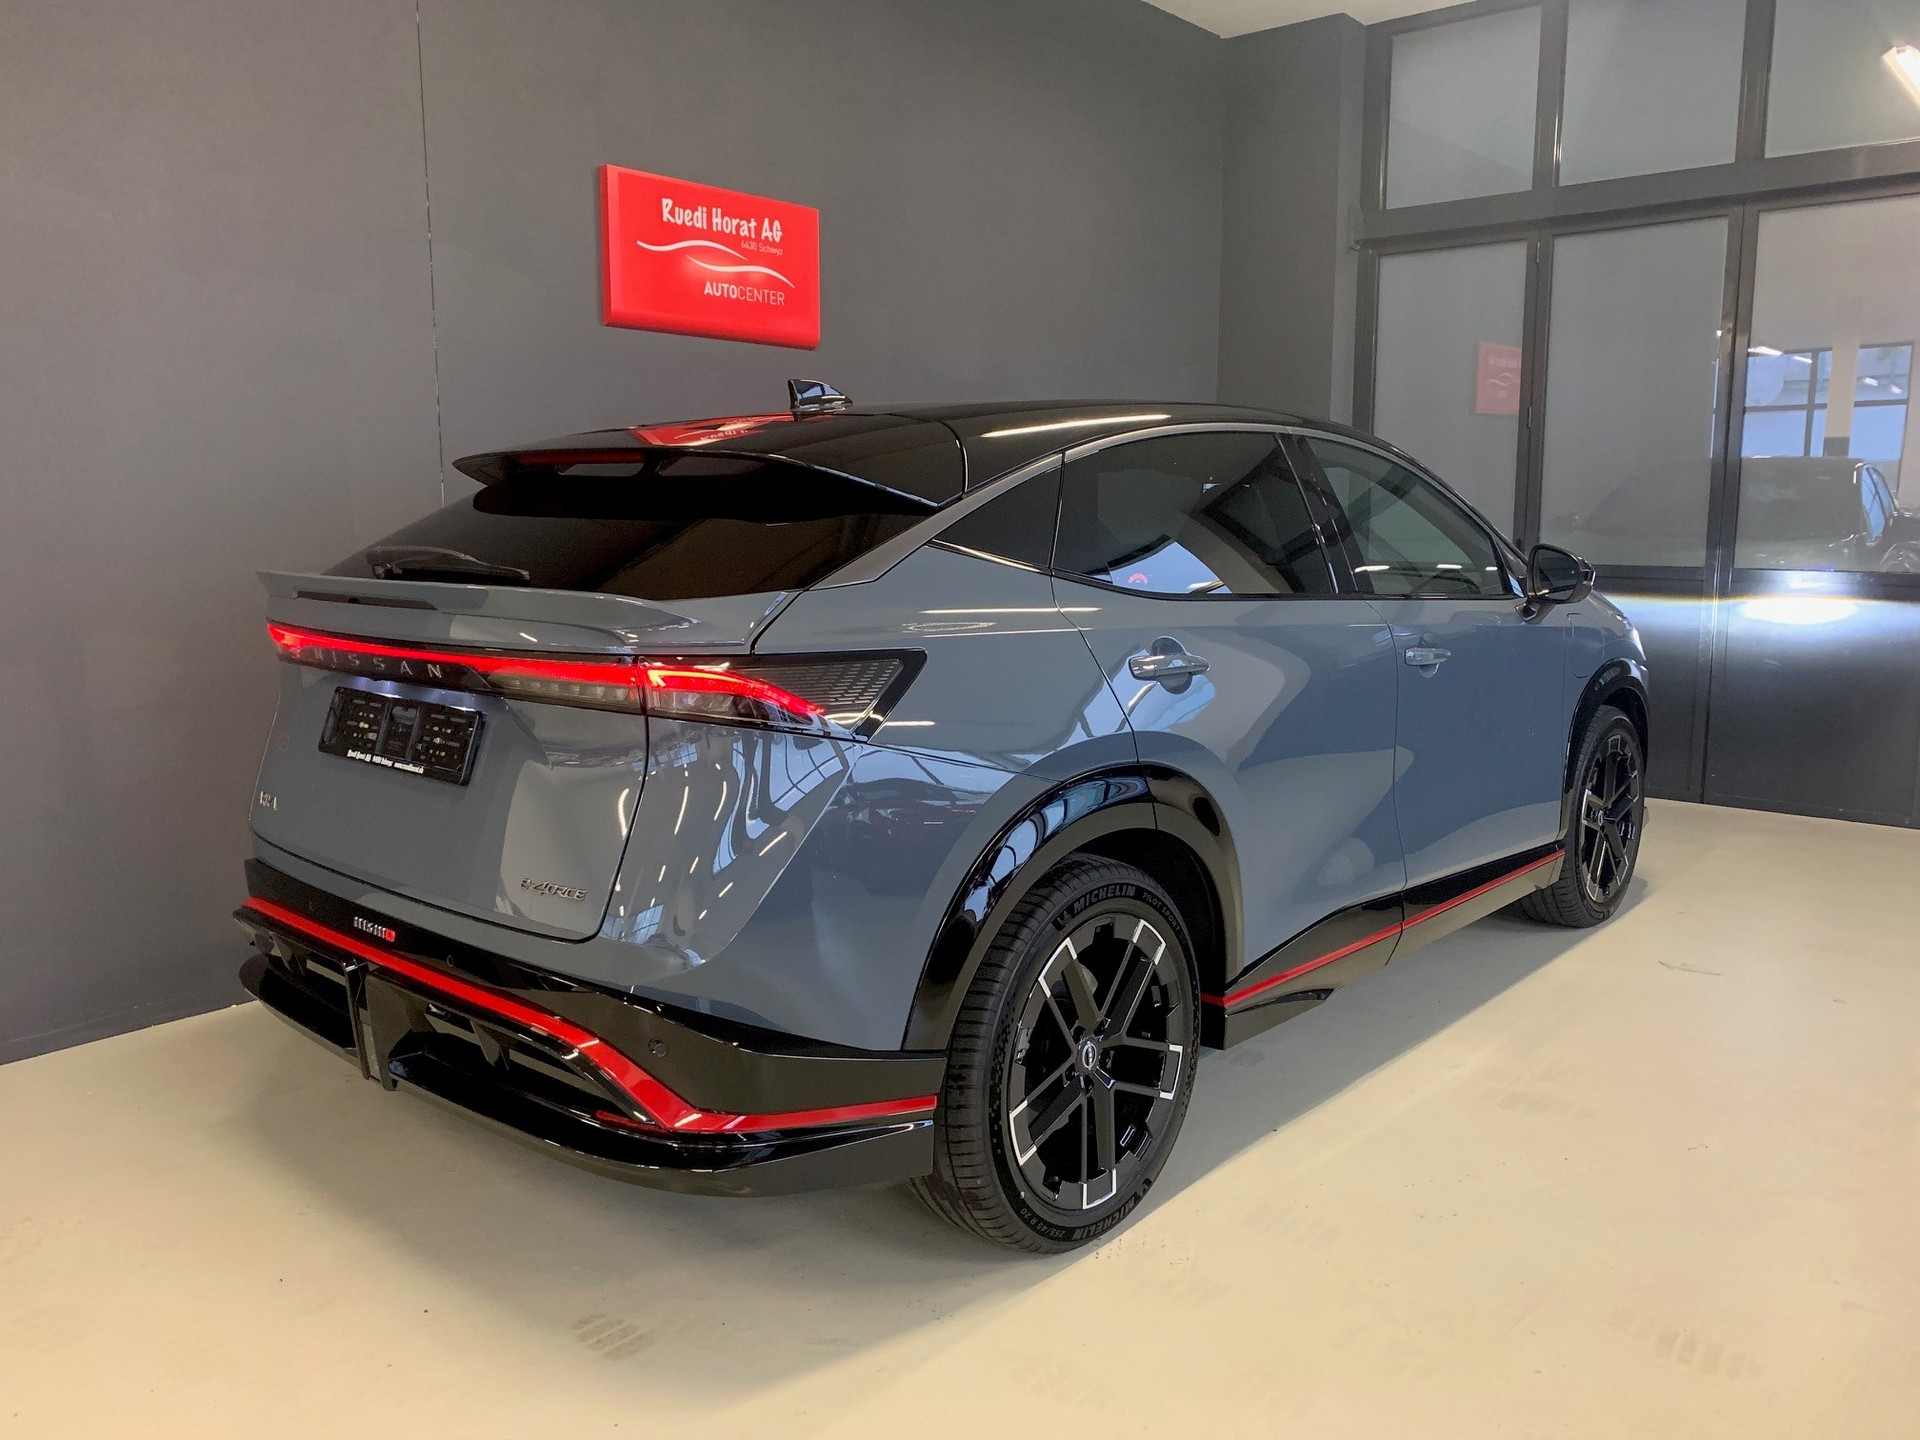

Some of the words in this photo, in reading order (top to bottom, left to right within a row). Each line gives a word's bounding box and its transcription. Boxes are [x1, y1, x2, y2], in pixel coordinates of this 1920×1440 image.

[661, 198, 707, 230] Ruedi
[712, 207, 757, 239] Horat
[761, 218, 783, 243] AG
[704, 281, 785, 306] AUTOCENTER
[314, 647, 442, 679] NISSAN
[1073, 884, 1136, 914] MICHELIN
[1142, 892, 1161, 909] PILOT
[1161, 907, 1181, 931] SPORT
[1072, 1198, 1136, 1241] MICHELIN
